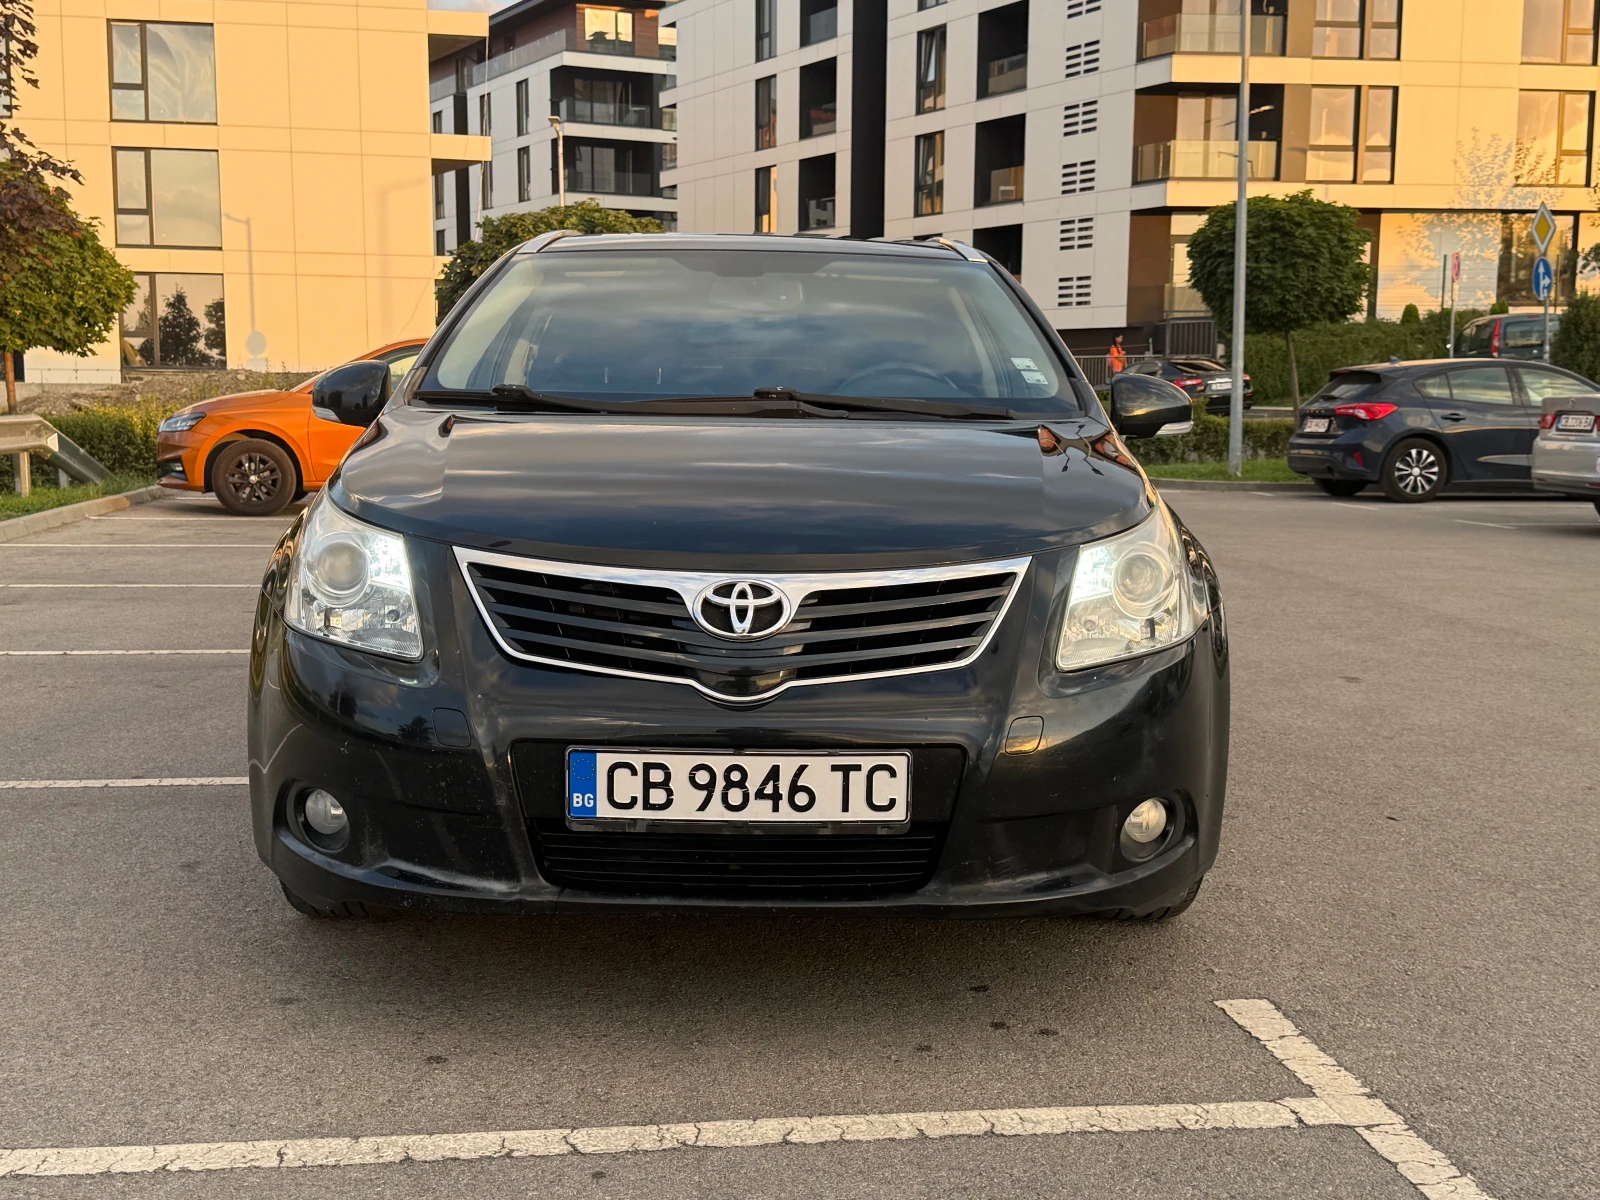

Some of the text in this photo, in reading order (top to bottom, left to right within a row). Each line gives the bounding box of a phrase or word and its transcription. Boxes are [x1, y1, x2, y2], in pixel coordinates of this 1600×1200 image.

[573, 793, 594, 807] BG
[606, 761, 898, 813] CB 9846 TC
